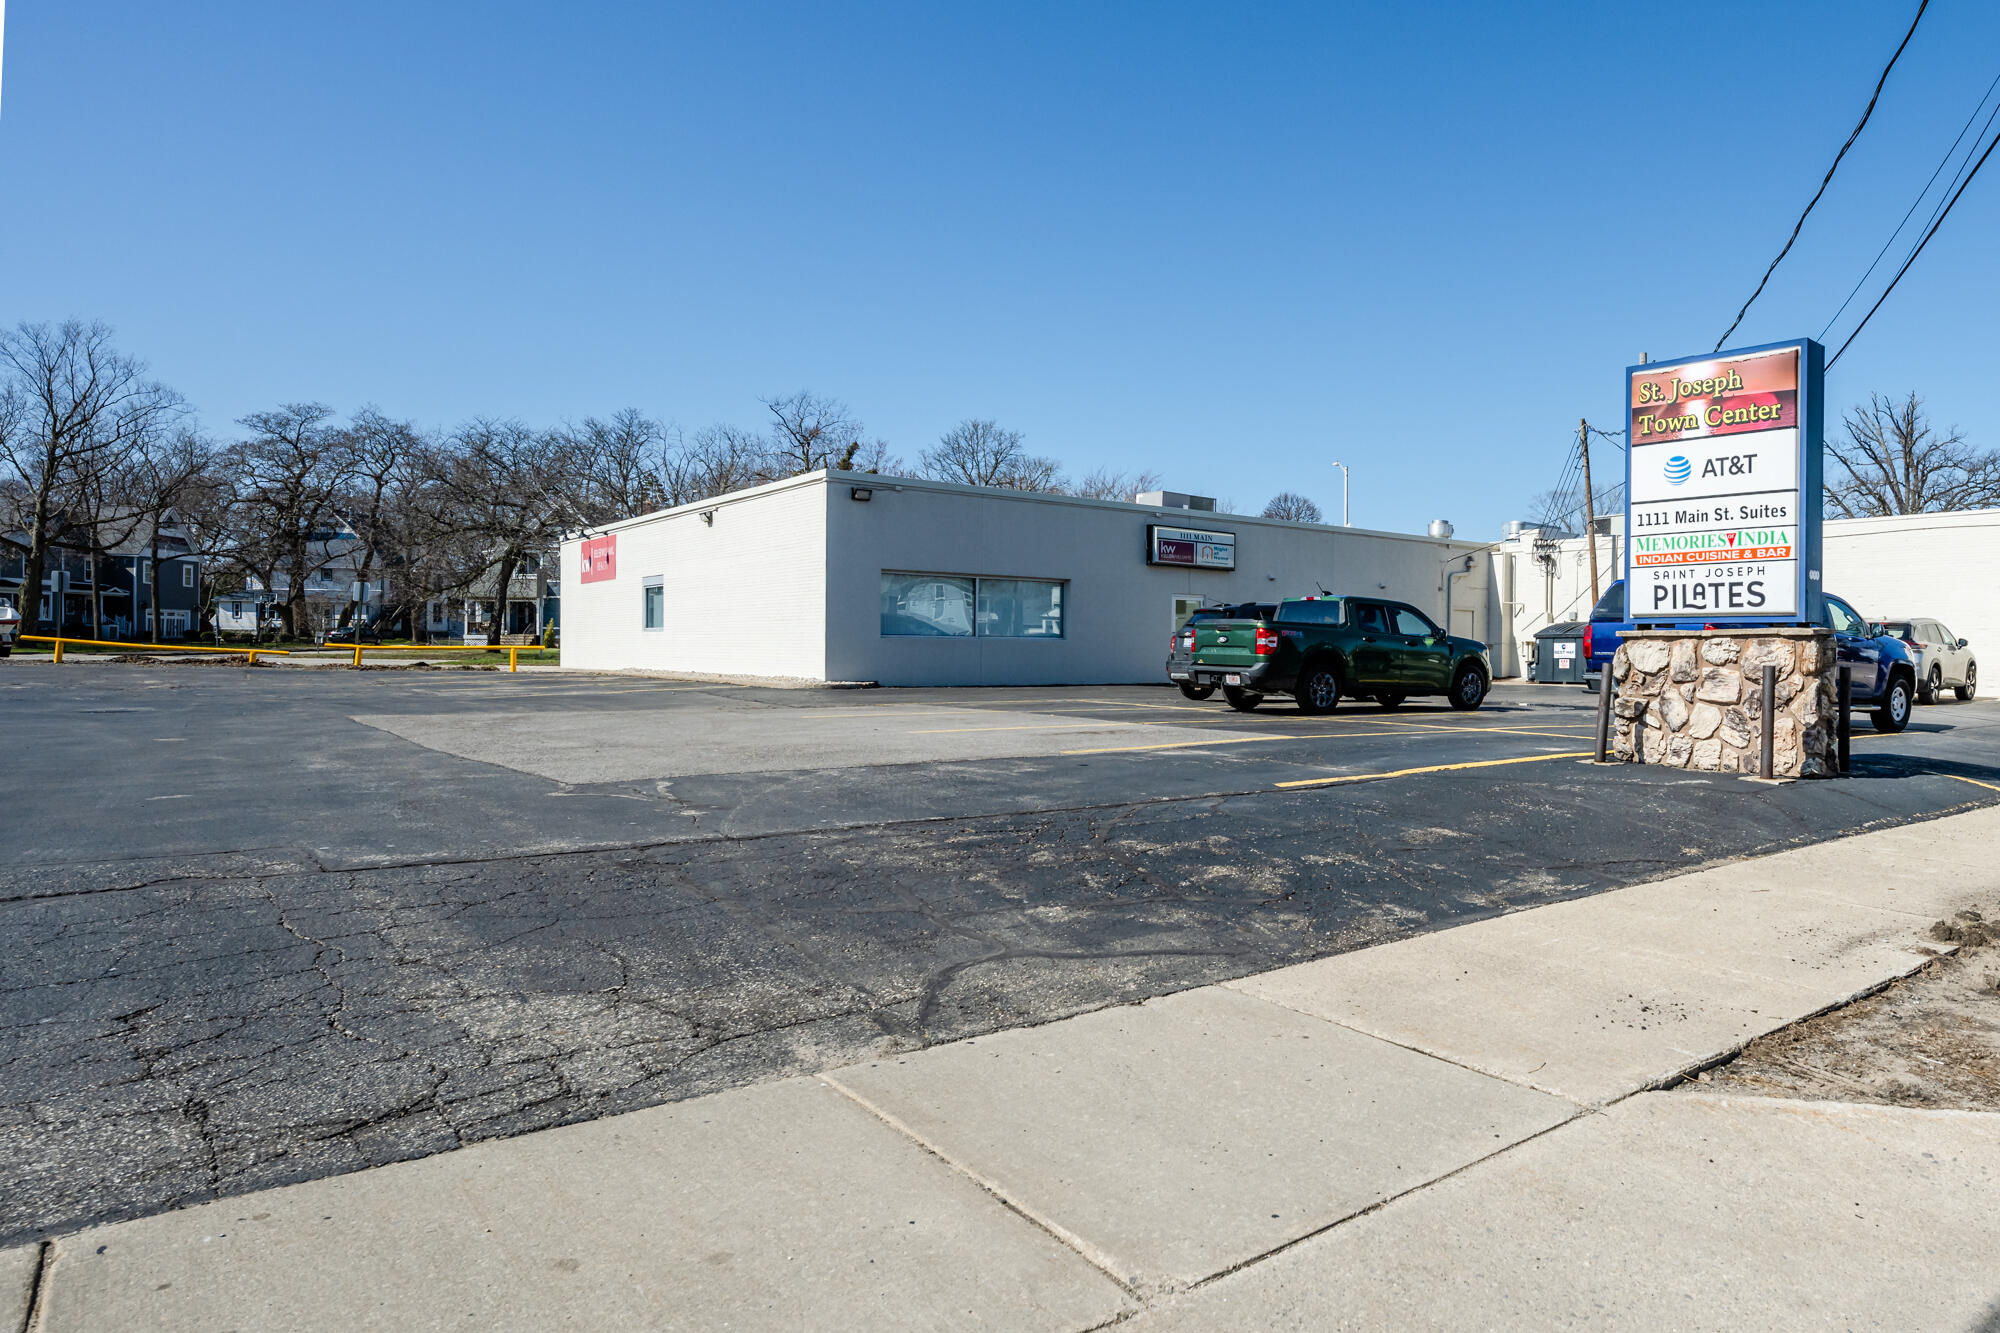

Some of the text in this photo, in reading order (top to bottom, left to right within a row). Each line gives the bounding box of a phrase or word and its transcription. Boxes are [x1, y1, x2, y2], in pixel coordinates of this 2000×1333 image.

[1639, 369, 1743, 404] St. Joseph
[1639, 402, 1782, 435] Town Center
[1702, 454, 1757, 478] AT&T
[1637, 505, 1787, 527] 1111 Main St. Suites
[1160, 541, 1176, 554] kw
[1193, 534, 1213, 542] MAIN
[1636, 532, 1727, 552] MEMORIES
[1737, 530, 1788, 546] INDIA
[1639, 547, 1786, 564] INDIAN CUISINE & BAR
[1653, 566, 1765, 580] SAINT JOSEPH
[1654, 581, 1766, 610] PILATES
